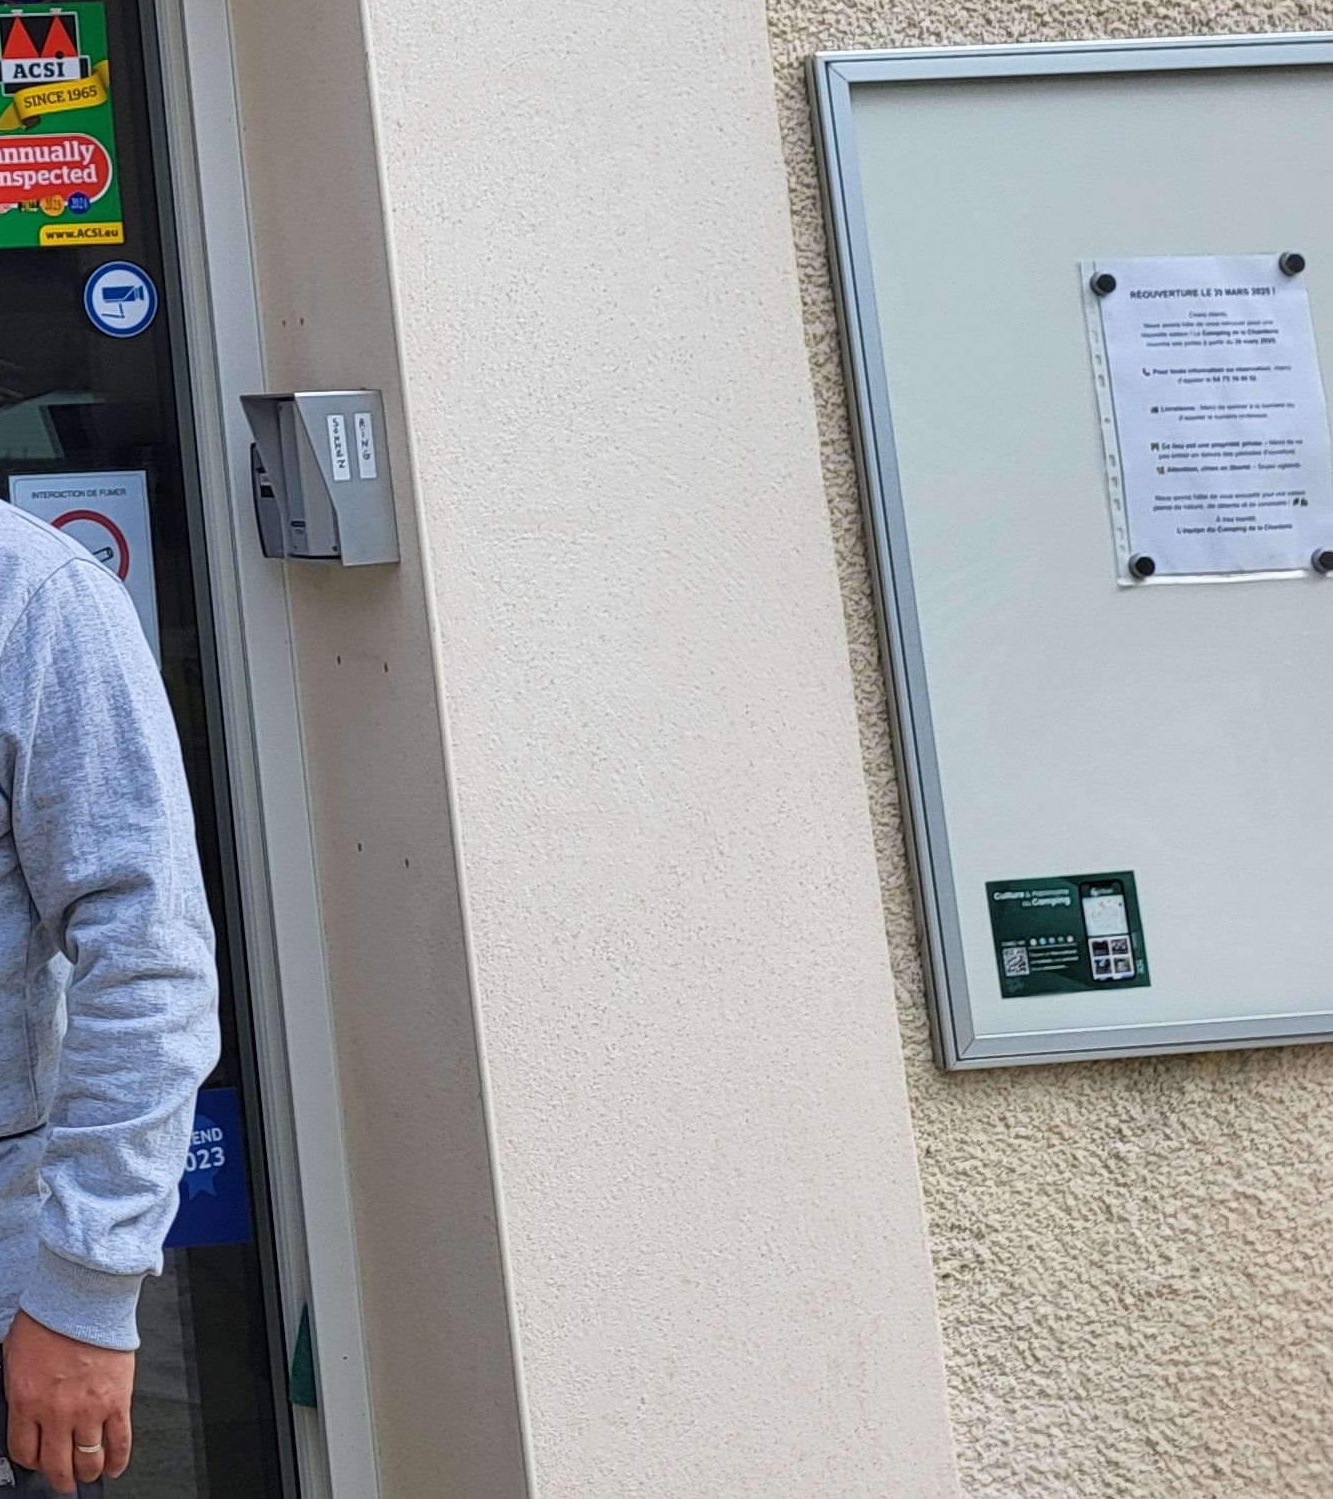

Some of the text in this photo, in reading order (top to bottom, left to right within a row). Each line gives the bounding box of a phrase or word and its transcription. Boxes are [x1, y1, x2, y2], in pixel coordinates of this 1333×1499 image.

[12, 61, 65, 79] ACSI
[23, 85, 98, 108] SINCE 1965
[86, 489, 98, 498] DE
[190, 1127, 224, 1146] END
[185, 1146, 226, 1173] 023
